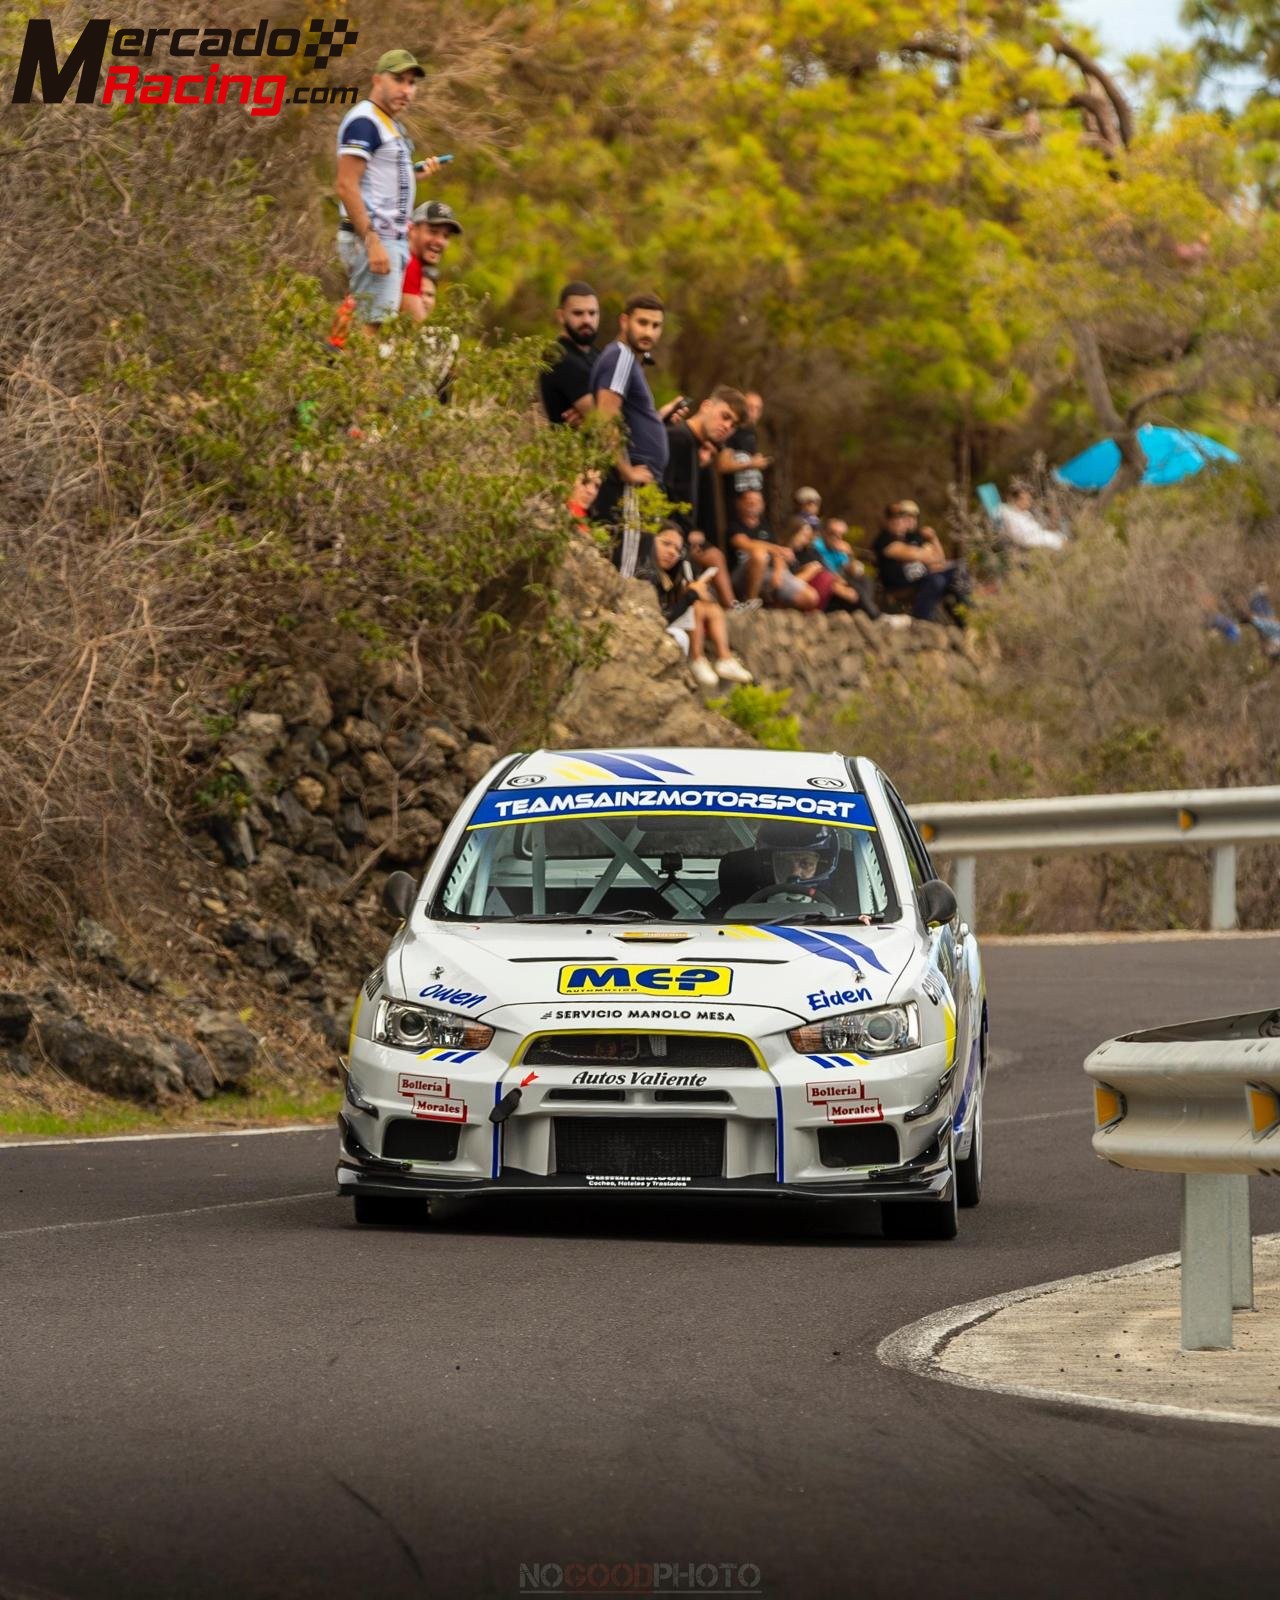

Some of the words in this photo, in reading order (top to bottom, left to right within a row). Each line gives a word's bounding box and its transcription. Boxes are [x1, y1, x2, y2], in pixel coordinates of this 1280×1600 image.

[495, 789, 856, 818] TEAMSAINZMOTORSPORT
[567, 967, 720, 991] MEP
[806, 987, 872, 1011] Eiden
[556, 1010, 622, 1019] SERVICIO
[628, 1011, 691, 1020] MANOLO
[697, 1012, 735, 1022] MESA
[572, 1071, 626, 1085] Autos
[630, 1072, 707, 1087] Valiente
[417, 1101, 460, 1113] Morales
[832, 1104, 875, 1116] Morales
